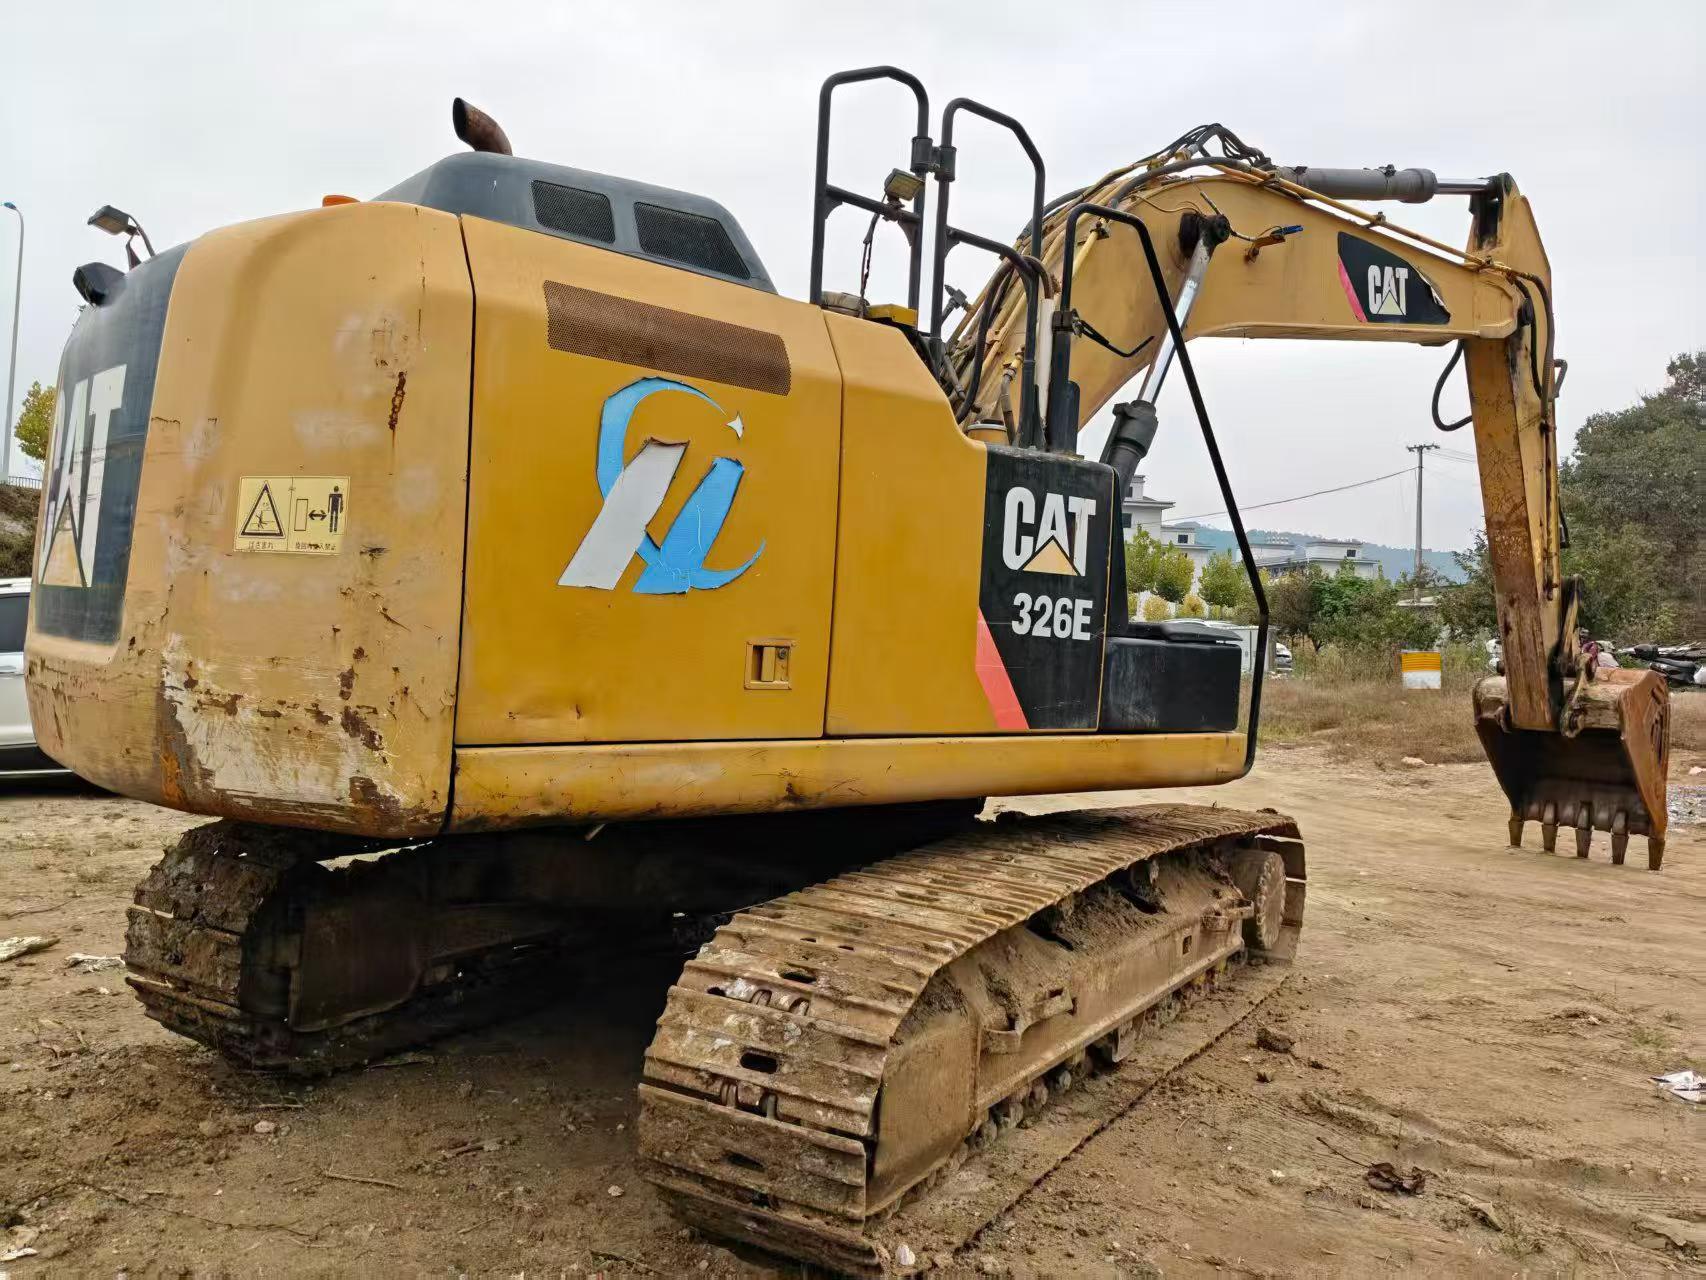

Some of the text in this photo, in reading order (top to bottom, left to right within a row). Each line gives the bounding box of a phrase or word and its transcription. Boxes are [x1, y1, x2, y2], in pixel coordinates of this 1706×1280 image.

[1367, 265, 1408, 315] CAT
[1002, 486, 1097, 577] CAT
[1011, 592, 1093, 641] 326E
